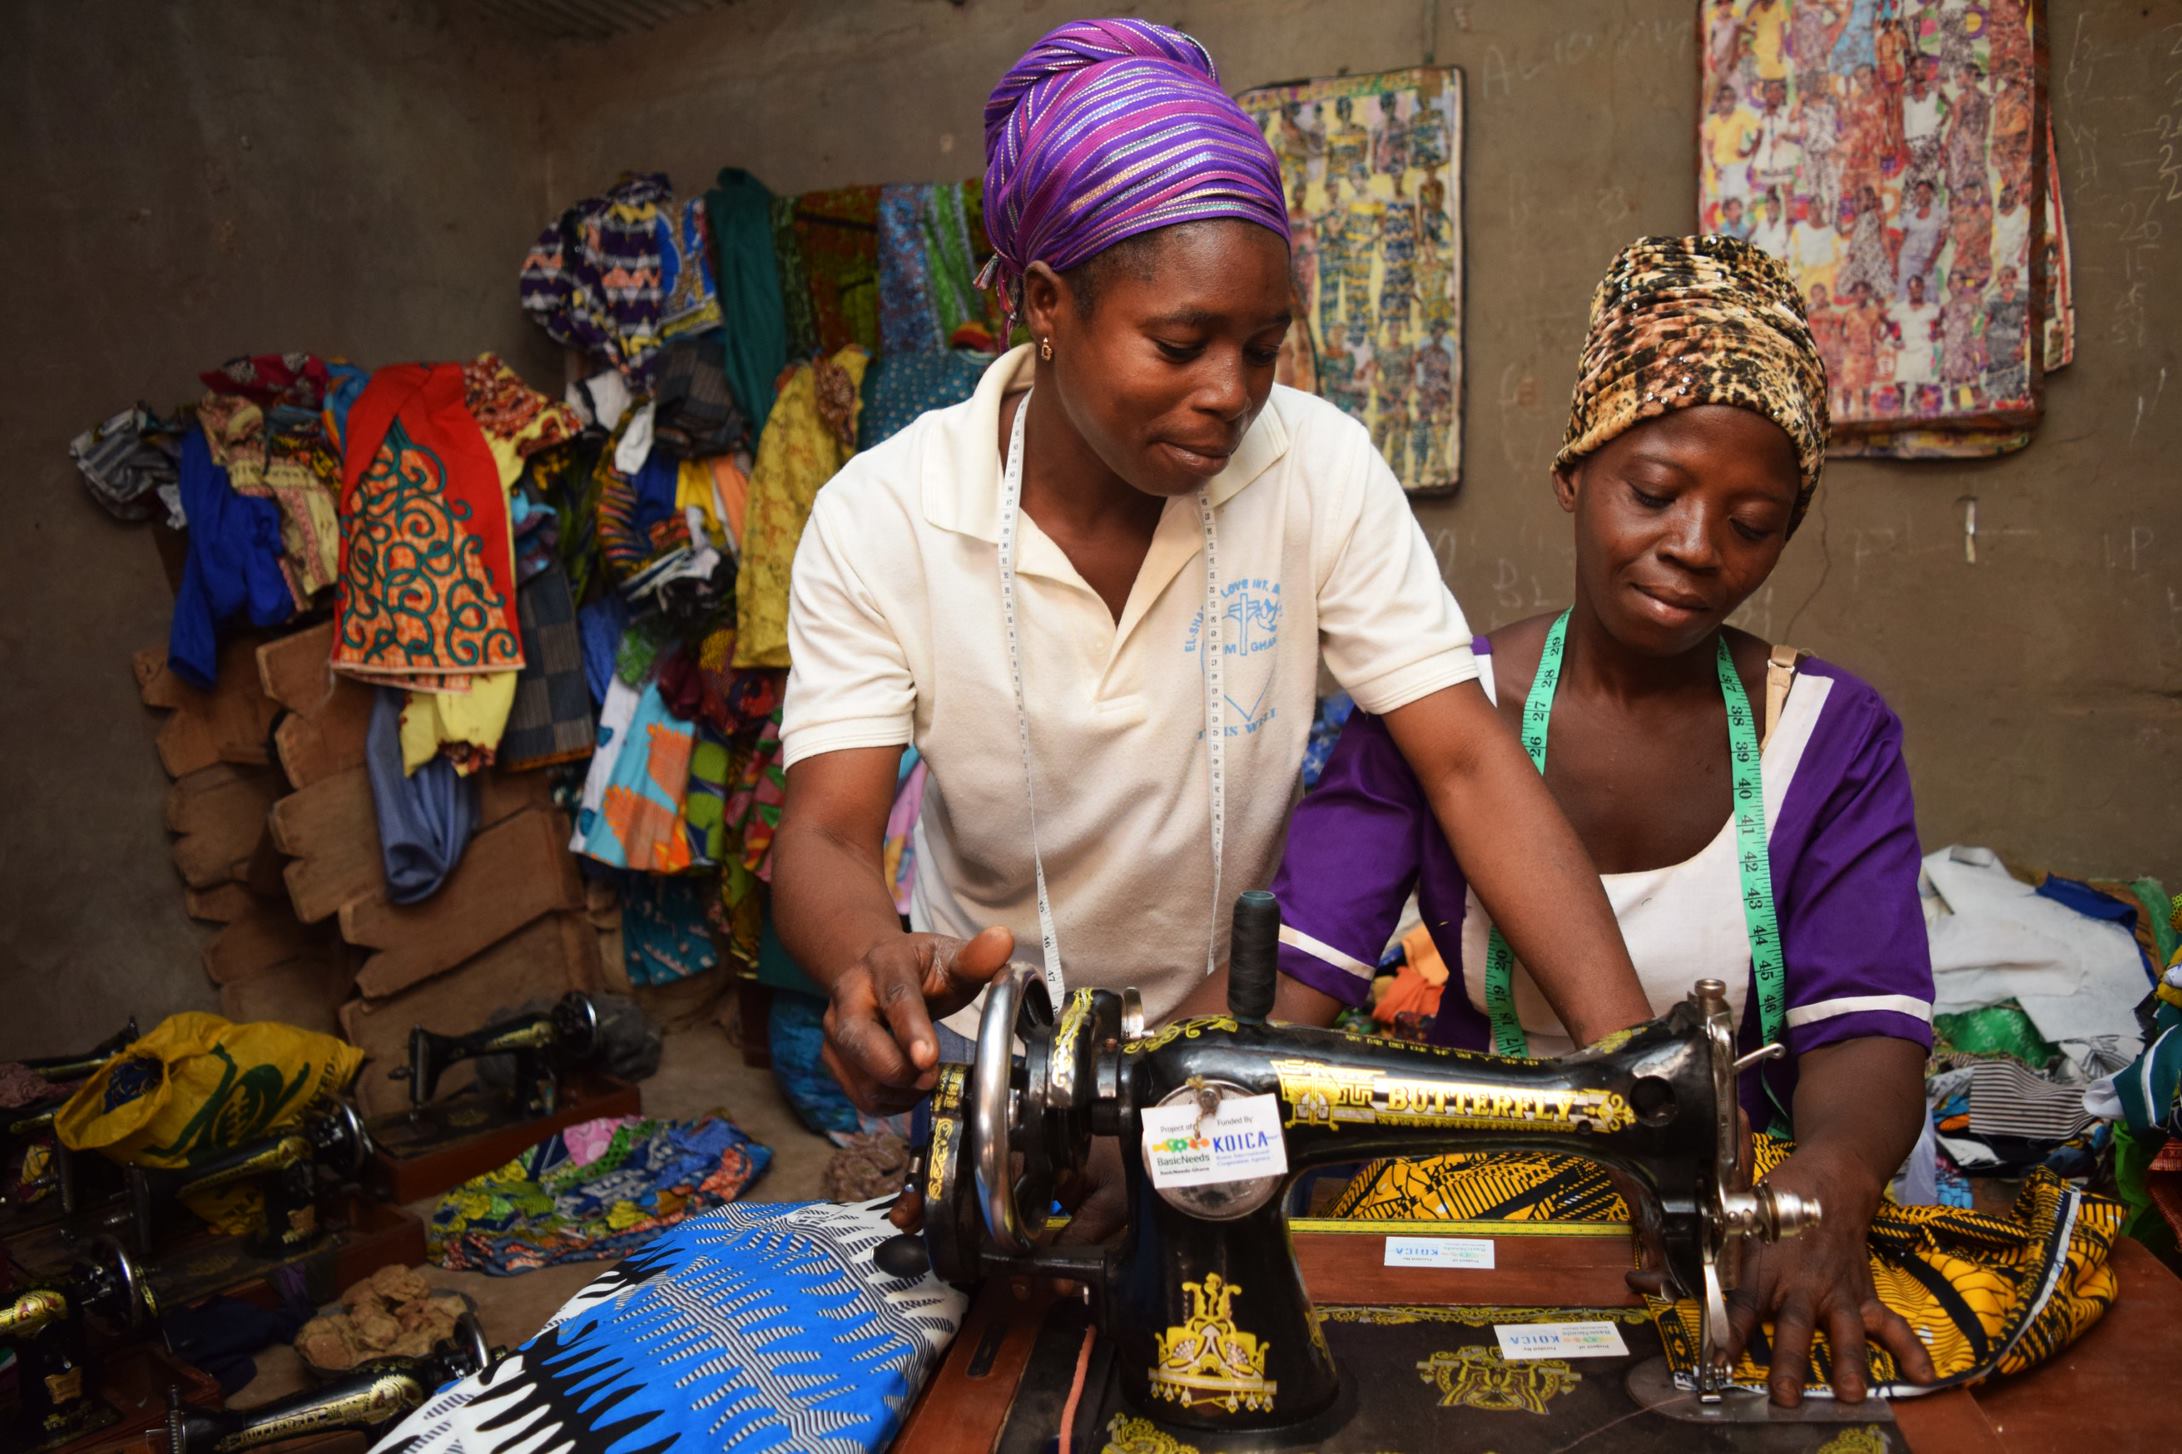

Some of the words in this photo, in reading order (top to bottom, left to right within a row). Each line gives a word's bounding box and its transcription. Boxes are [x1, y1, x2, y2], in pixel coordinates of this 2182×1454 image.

[1550, 636, 1561, 657] 29
[1541, 669, 1554, 688] 28
[1532, 702, 1546, 722] 27
[1731, 705, 1744, 726] 38
[1530, 736, 1542, 758] 26
[1736, 741, 1750, 763] 39
[1738, 777, 1752, 799] 40
[1741, 815, 1755, 835] 41
[1744, 851, 1759, 873] 42
[1747, 888, 1763, 910] 43
[1753, 925, 1769, 946] 44
[1759, 960, 1774, 981] 45
[1386, 1086, 1576, 1122] BUTTERFLY
[1217, 1118, 1242, 1127] Funded
[1213, 1131, 1268, 1153] KOICA
[1157, 1153, 1210, 1167] BasicNeeds
[1395, 1247, 1439, 1256] KOICA
[1510, 1335, 1560, 1345] KOICA
